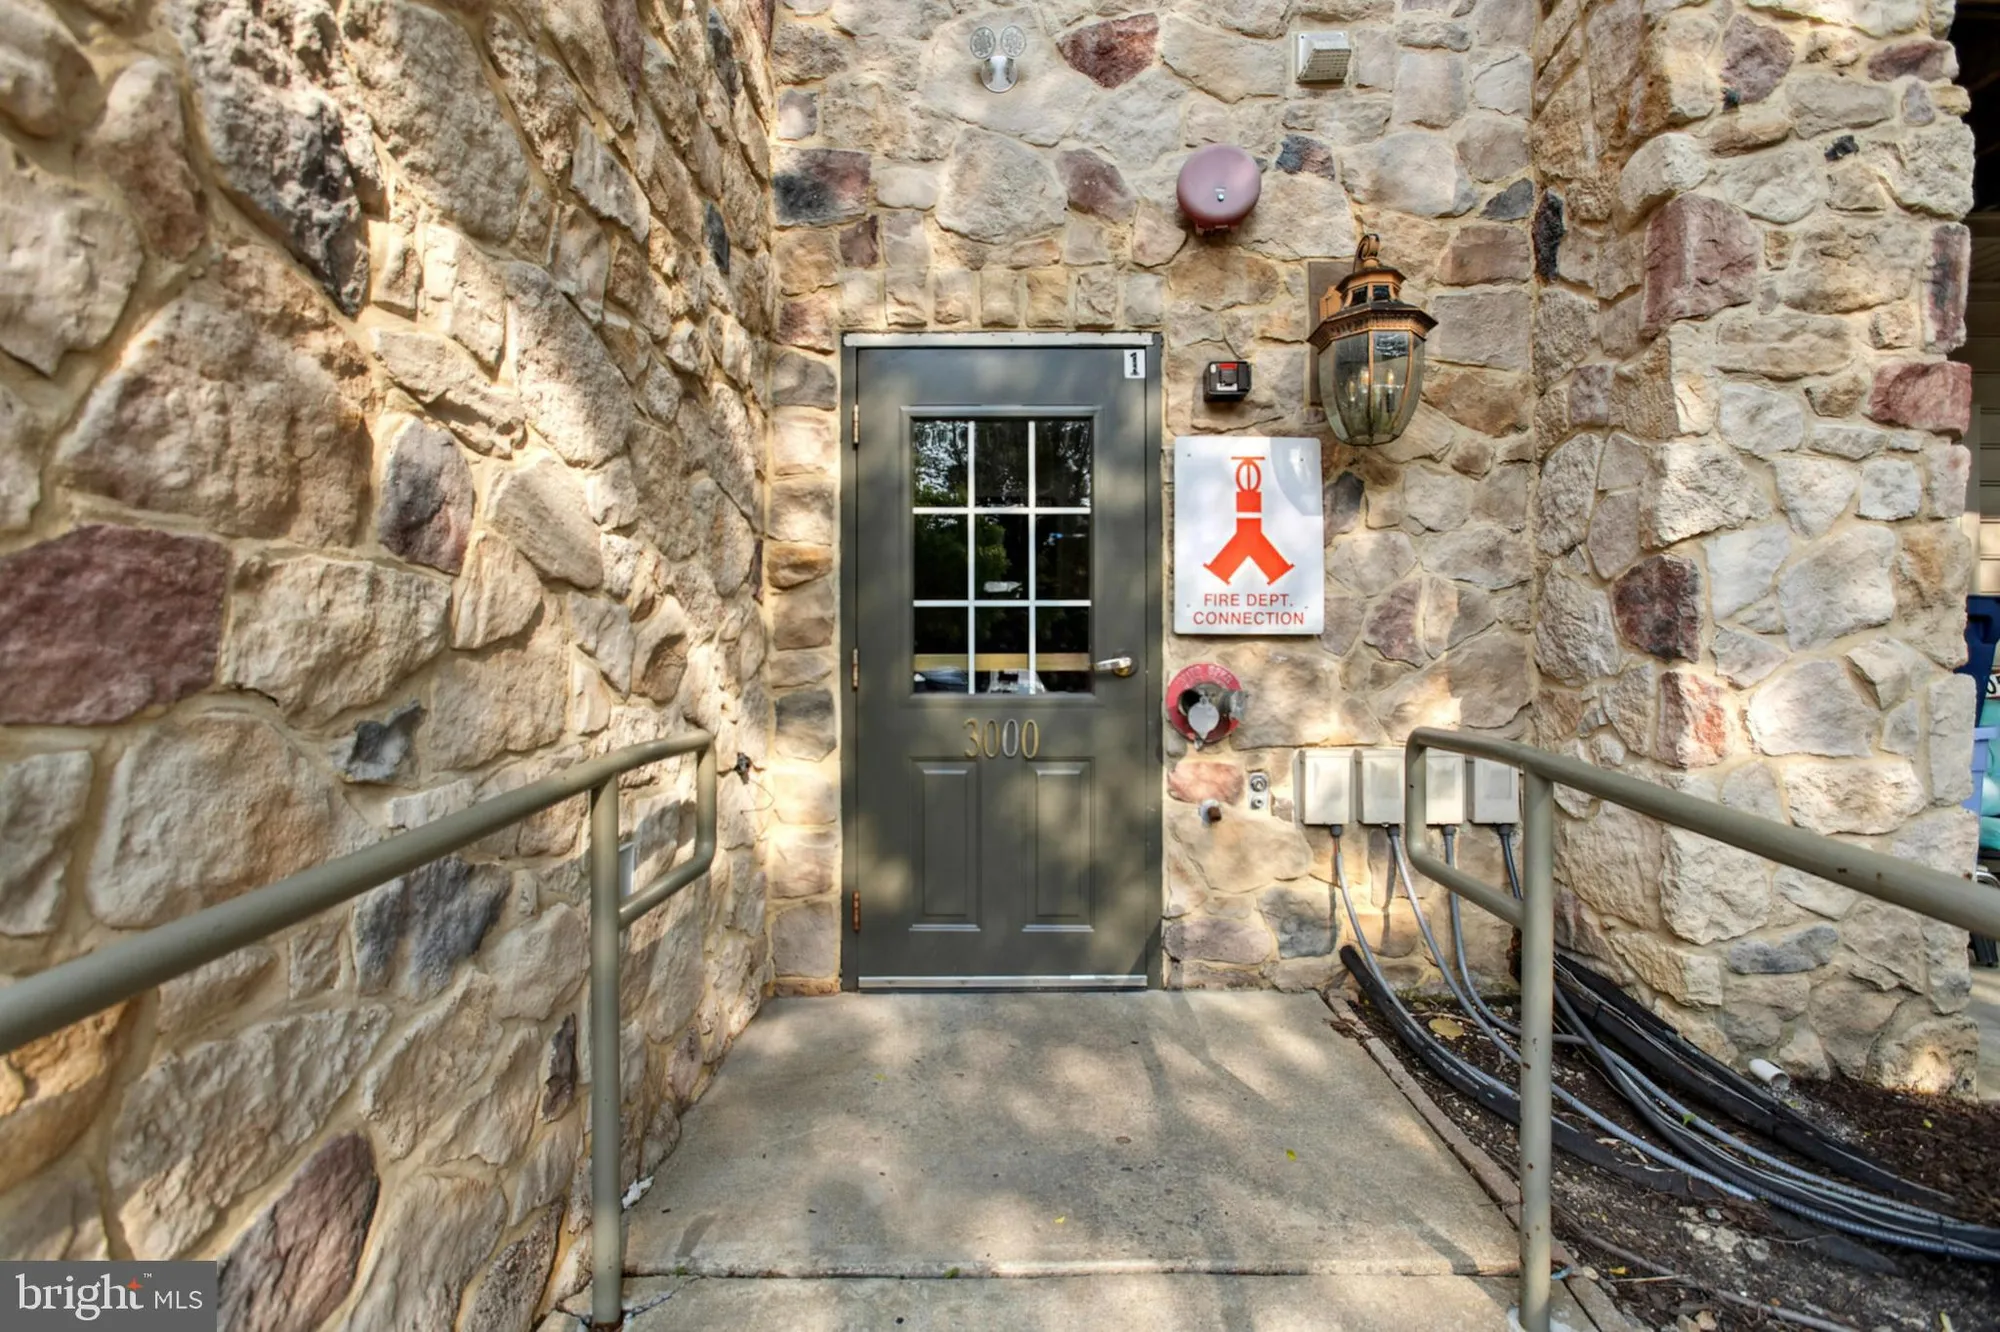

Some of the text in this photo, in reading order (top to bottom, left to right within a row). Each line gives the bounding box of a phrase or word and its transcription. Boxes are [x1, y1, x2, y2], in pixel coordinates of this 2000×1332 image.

[1130, 352, 1140, 376] 1
[1204, 593, 1293, 607] FIRE DEPT.
[1193, 611, 1304, 625] CONNECTION
[963, 718, 1039, 759] 3000
